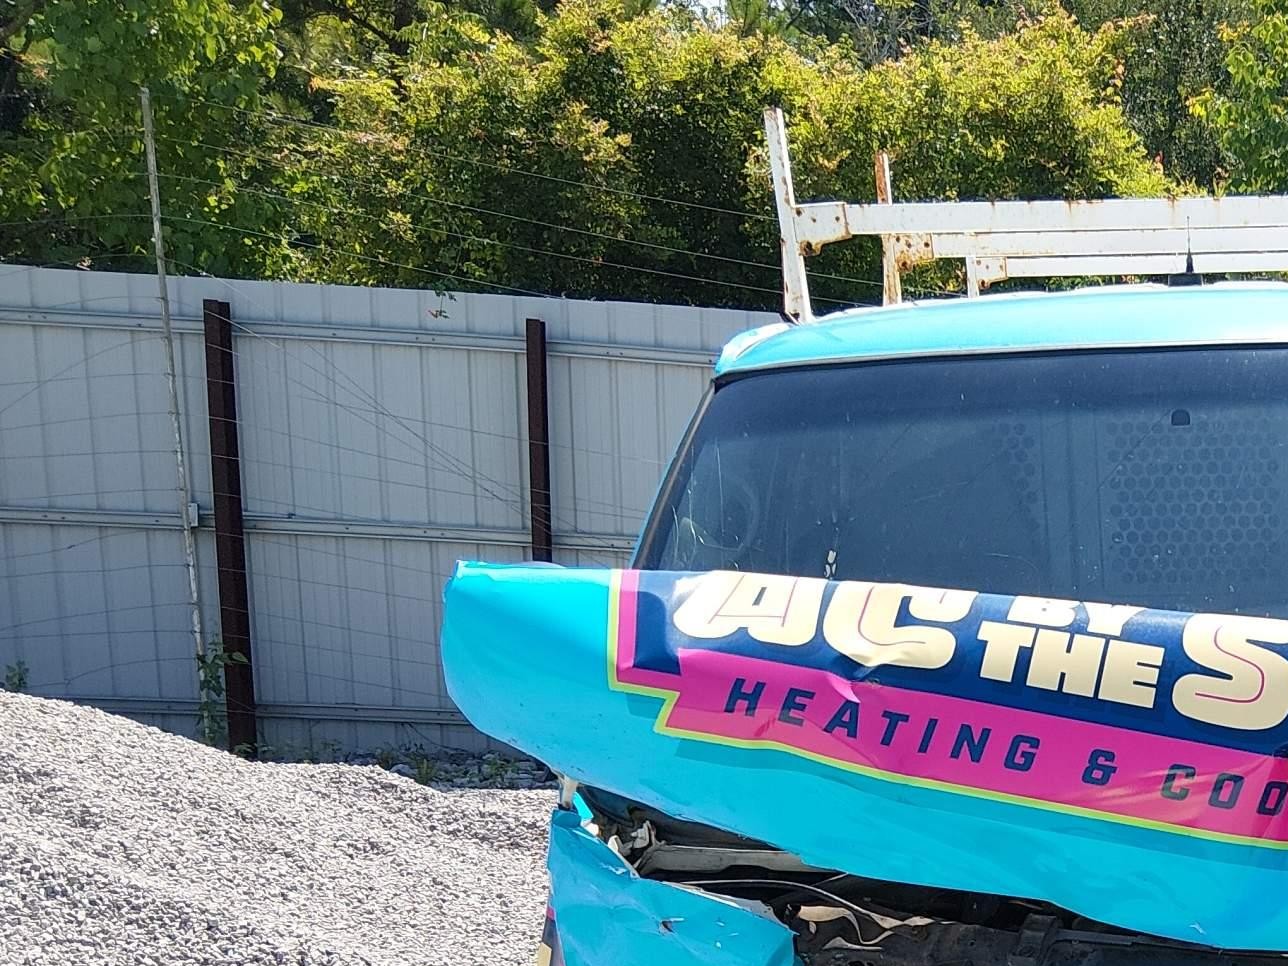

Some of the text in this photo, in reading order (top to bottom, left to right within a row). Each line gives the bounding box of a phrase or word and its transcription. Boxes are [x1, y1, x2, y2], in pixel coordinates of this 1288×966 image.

[672, 569, 979, 670] AC
[1006, 595, 1147, 637] BY
[976, 621, 1166, 709] THE
[722, 676, 1042, 773] HEATING
[1080, 749, 1118, 786] &
